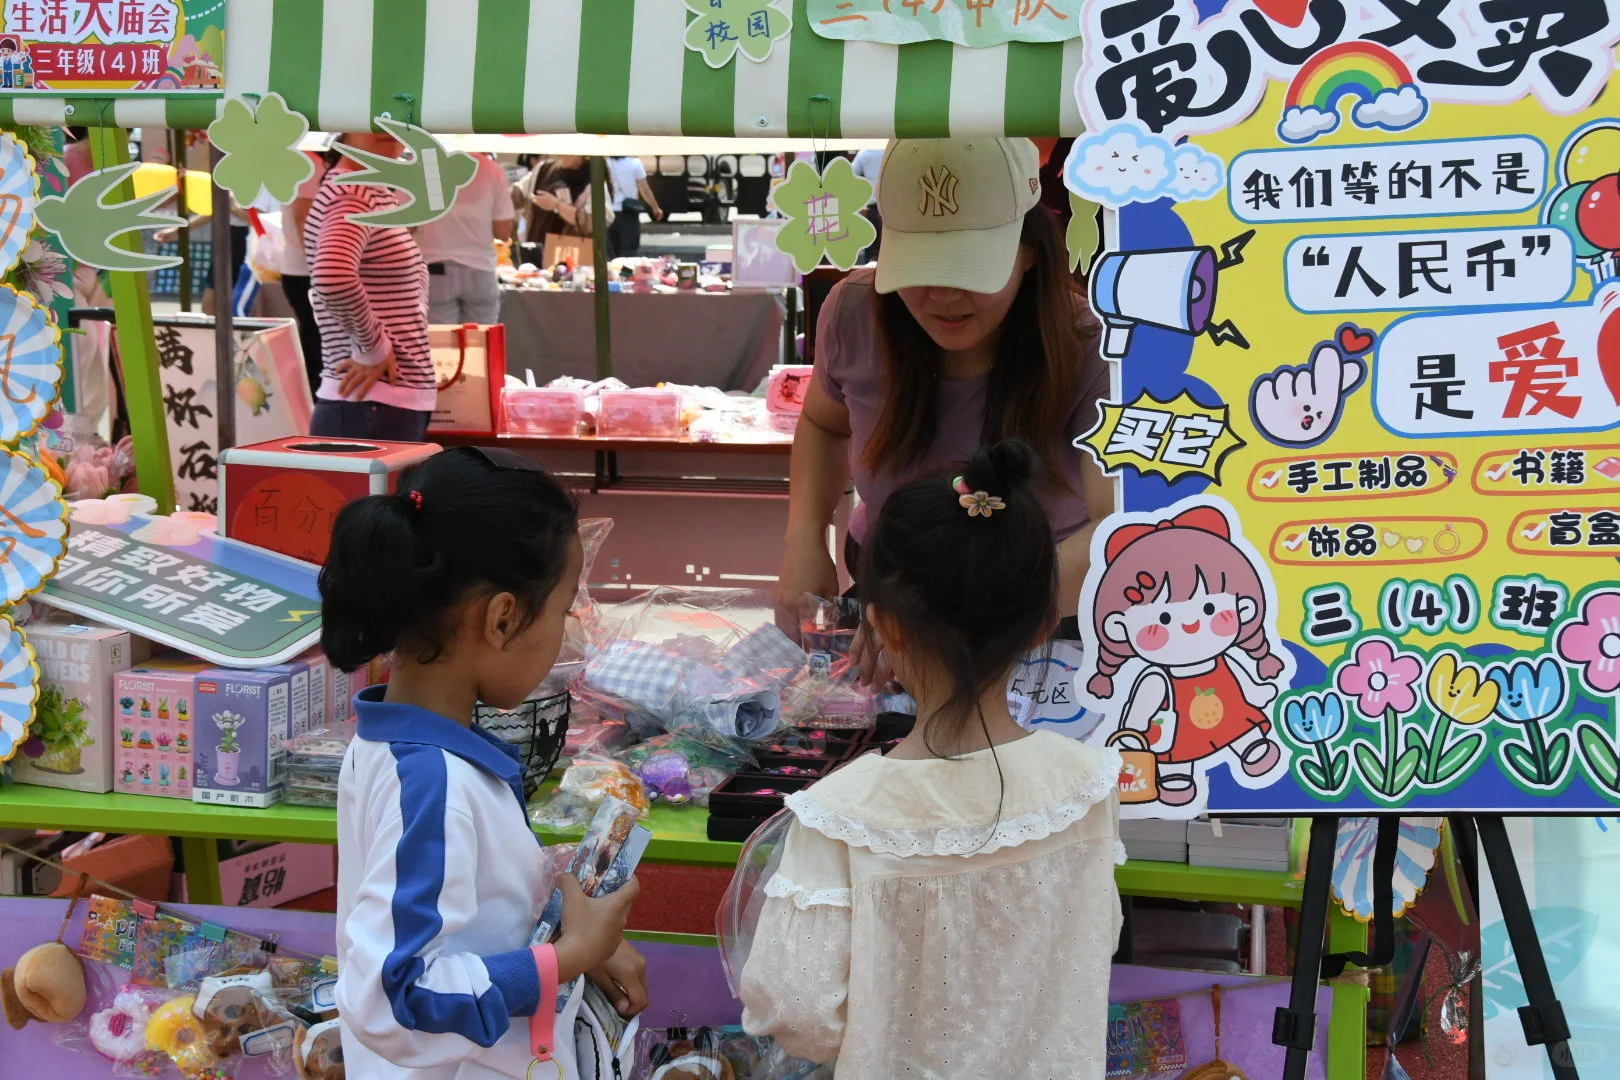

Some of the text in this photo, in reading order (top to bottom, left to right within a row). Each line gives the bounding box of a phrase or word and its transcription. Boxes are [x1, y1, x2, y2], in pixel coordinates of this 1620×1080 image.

[11, 0, 171, 37] 生活大庙会
[704, 10, 771, 50] 校园
[36, 48, 161, 76] 三年级(4)班
[918, 165, 960, 217] NY
[1242, 152, 1536, 211] 我们等的不是
[803, 192, 850, 246] 花
[1302, 235, 1552, 299] “人民币”
[1103, 406, 1224, 468] 买它
[1286, 455, 1429, 495] 手工制品
[1511, 450, 1585, 485] 书籍
[1308, 523, 1379, 558] 饰品
[1549, 511, 1620, 546] 盲盒
[67, 529, 289, 613] 精致好物
[1310, 580, 1559, 637] 三(4)班
[119, 679, 155, 692] FLORIST
[225, 683, 262, 696] FLORIST
[201, 791, 254, 804] 国产积木
